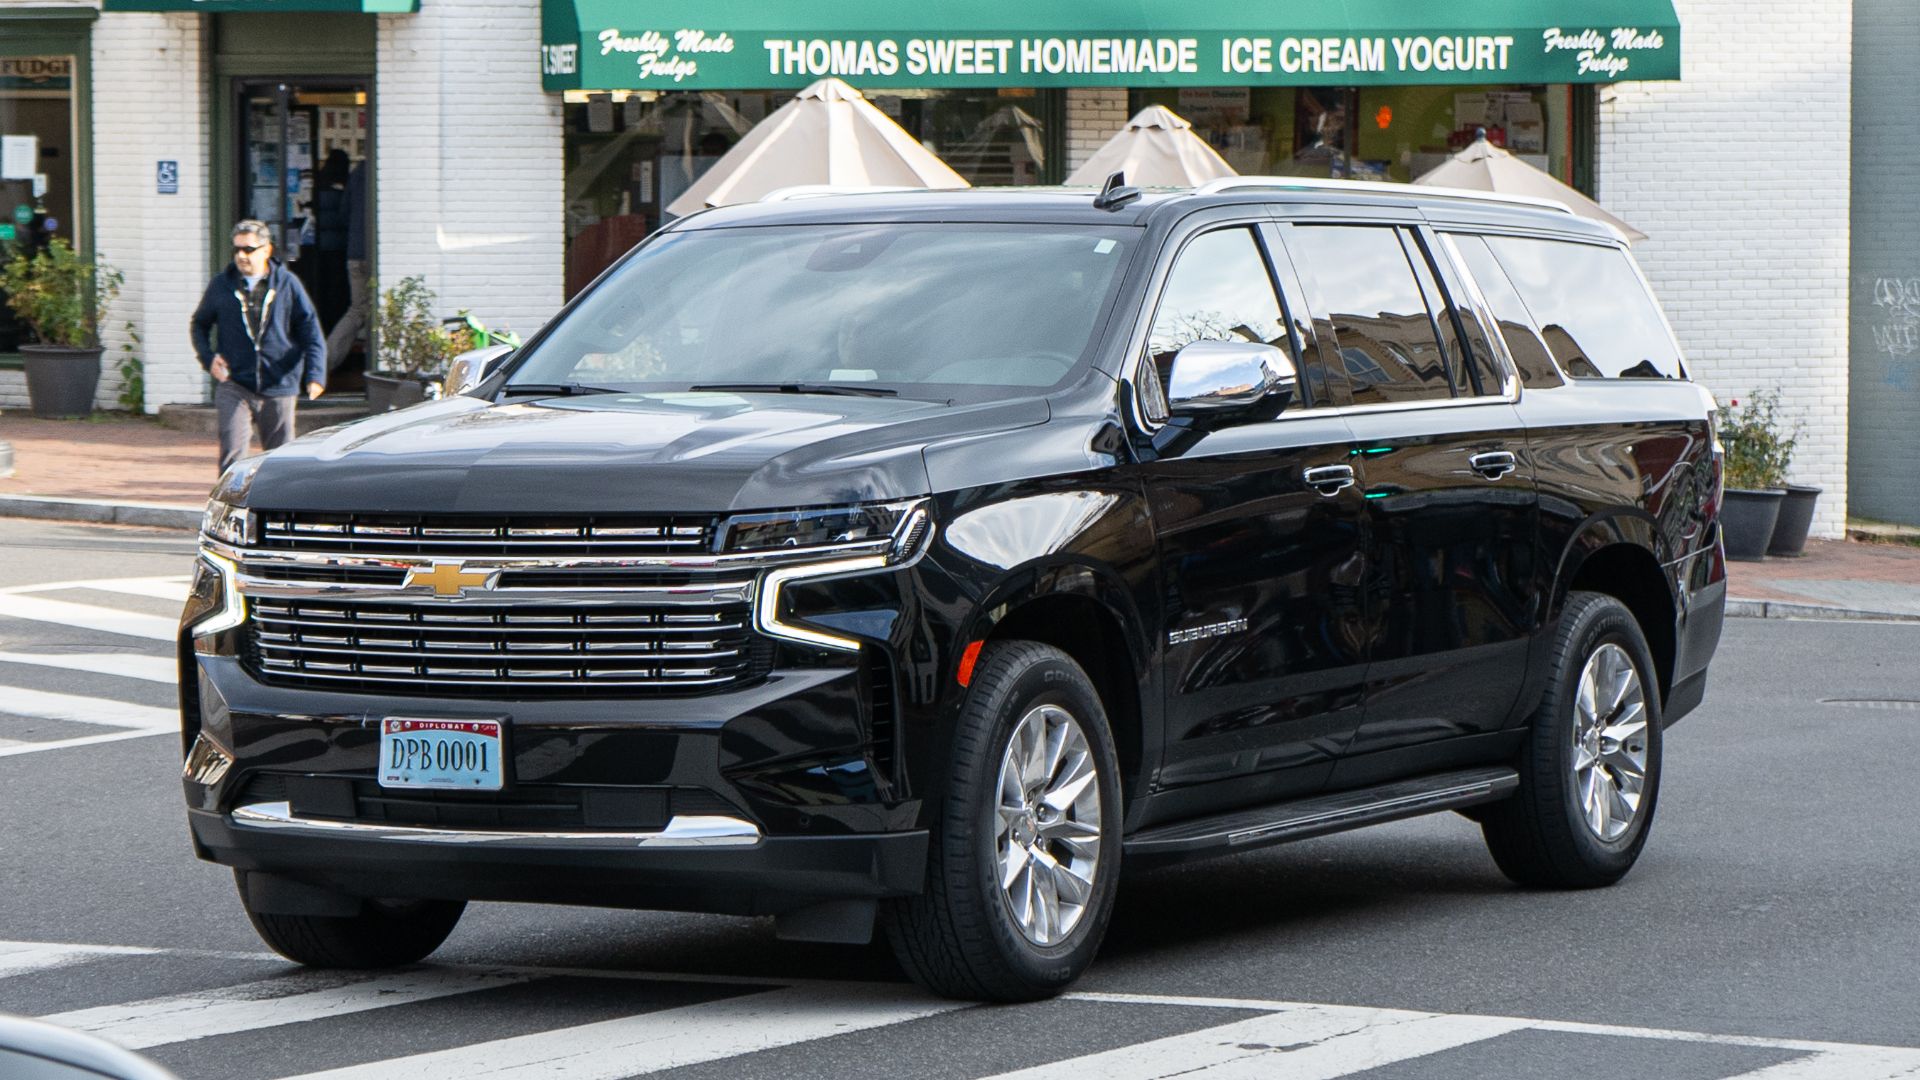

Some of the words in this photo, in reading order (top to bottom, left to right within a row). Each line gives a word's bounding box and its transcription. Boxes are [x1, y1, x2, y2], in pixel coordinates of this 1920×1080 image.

[598, 28, 669, 57] Freshly
[674, 28, 734, 53] Made
[1543, 27, 1605, 54] Freshly
[1611, 27, 1664, 50] Made
[637, 53, 697, 82] Fudge
[763, 39, 899, 75] THOMAS
[906, 39, 1013, 75] SWEET
[1020, 38, 1198, 74] HOMEMADE
[1222, 38, 1272, 73] ICE
[1279, 37, 1385, 73] CREAM
[1391, 36, 1514, 72] YOGURT
[1577, 50, 1629, 78] Fudge
[1169, 617, 1248, 645] SUBURBAN
[419, 722, 465, 730] DIPLOMAT
